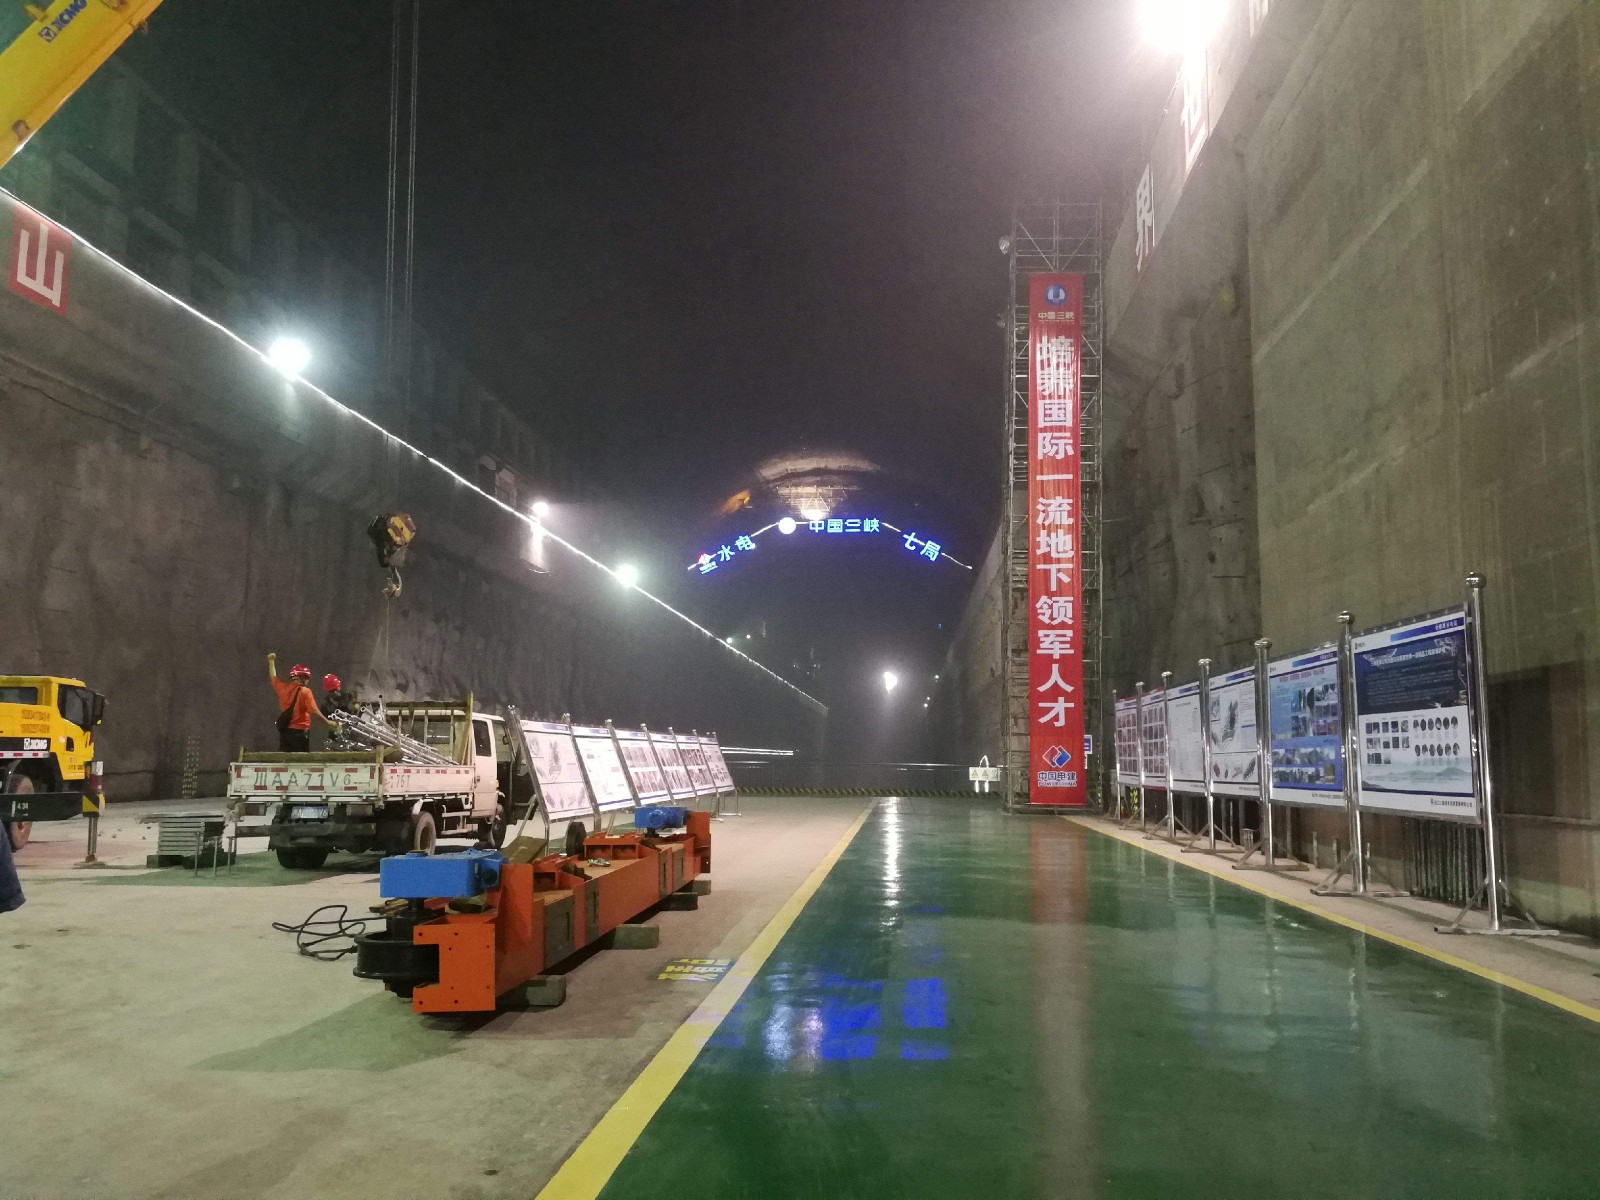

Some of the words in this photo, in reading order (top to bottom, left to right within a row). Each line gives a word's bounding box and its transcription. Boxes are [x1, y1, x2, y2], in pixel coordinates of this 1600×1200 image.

[51, 0, 87, 31] XCMG
[1038, 311, 1074, 320] 中国三峡
[809, 518, 880, 533] 中国三峡
[903, 532, 941, 562] 七局
[1038, 771, 1077, 781] 中国电建
